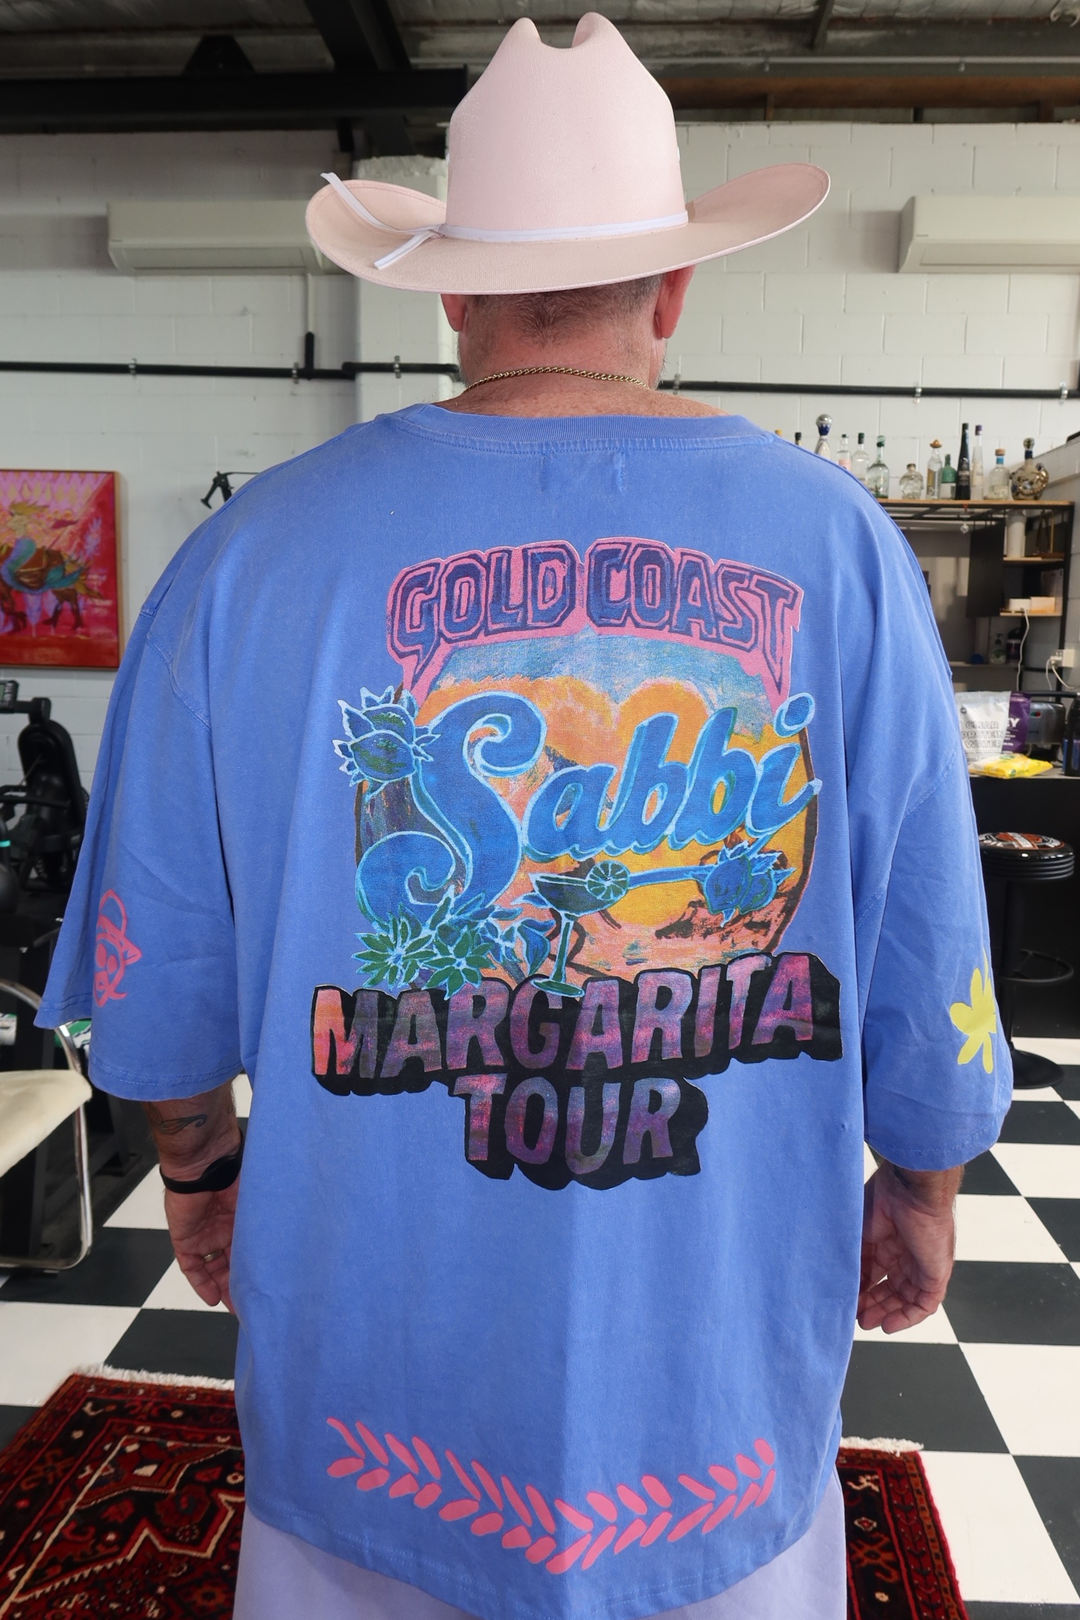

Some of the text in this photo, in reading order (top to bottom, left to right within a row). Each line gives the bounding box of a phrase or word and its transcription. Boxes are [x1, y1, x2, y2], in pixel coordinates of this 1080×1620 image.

[389, 541, 802, 696] GOLD COAST
[961, 730, 1004, 739] PROTEIN
[965, 720, 1000, 730] CLEAR
[965, 739, 1001, 749] WATER
[355, 690, 823, 922] Sabbi
[313, 953, 815, 1078] MARGARITA
[452, 1073, 682, 1175] TOUR
